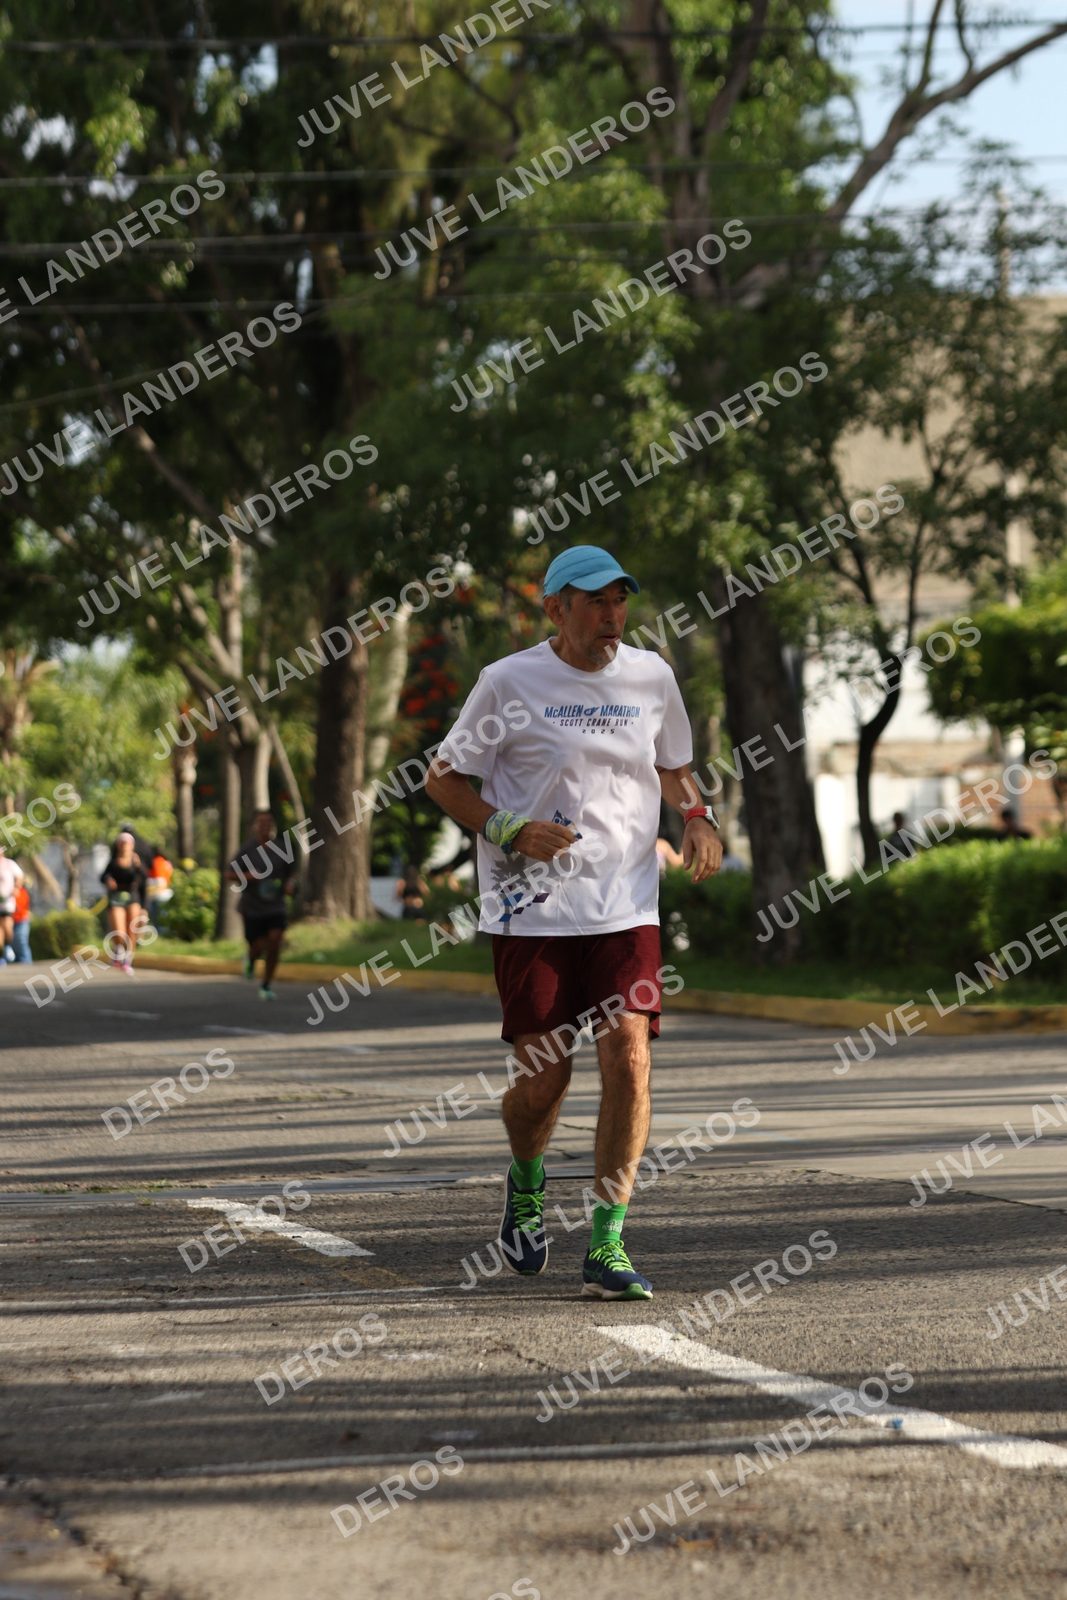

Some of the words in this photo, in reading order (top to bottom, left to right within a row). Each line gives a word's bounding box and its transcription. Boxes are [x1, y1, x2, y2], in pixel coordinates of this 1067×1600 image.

[544, 704, 584, 718] McALLEN
[600, 704, 641, 718] MARATHON
[559, 717, 584, 727] SCOTT
[586, 717, 611, 727] CRANE
[615, 717, 628, 727] RUN
